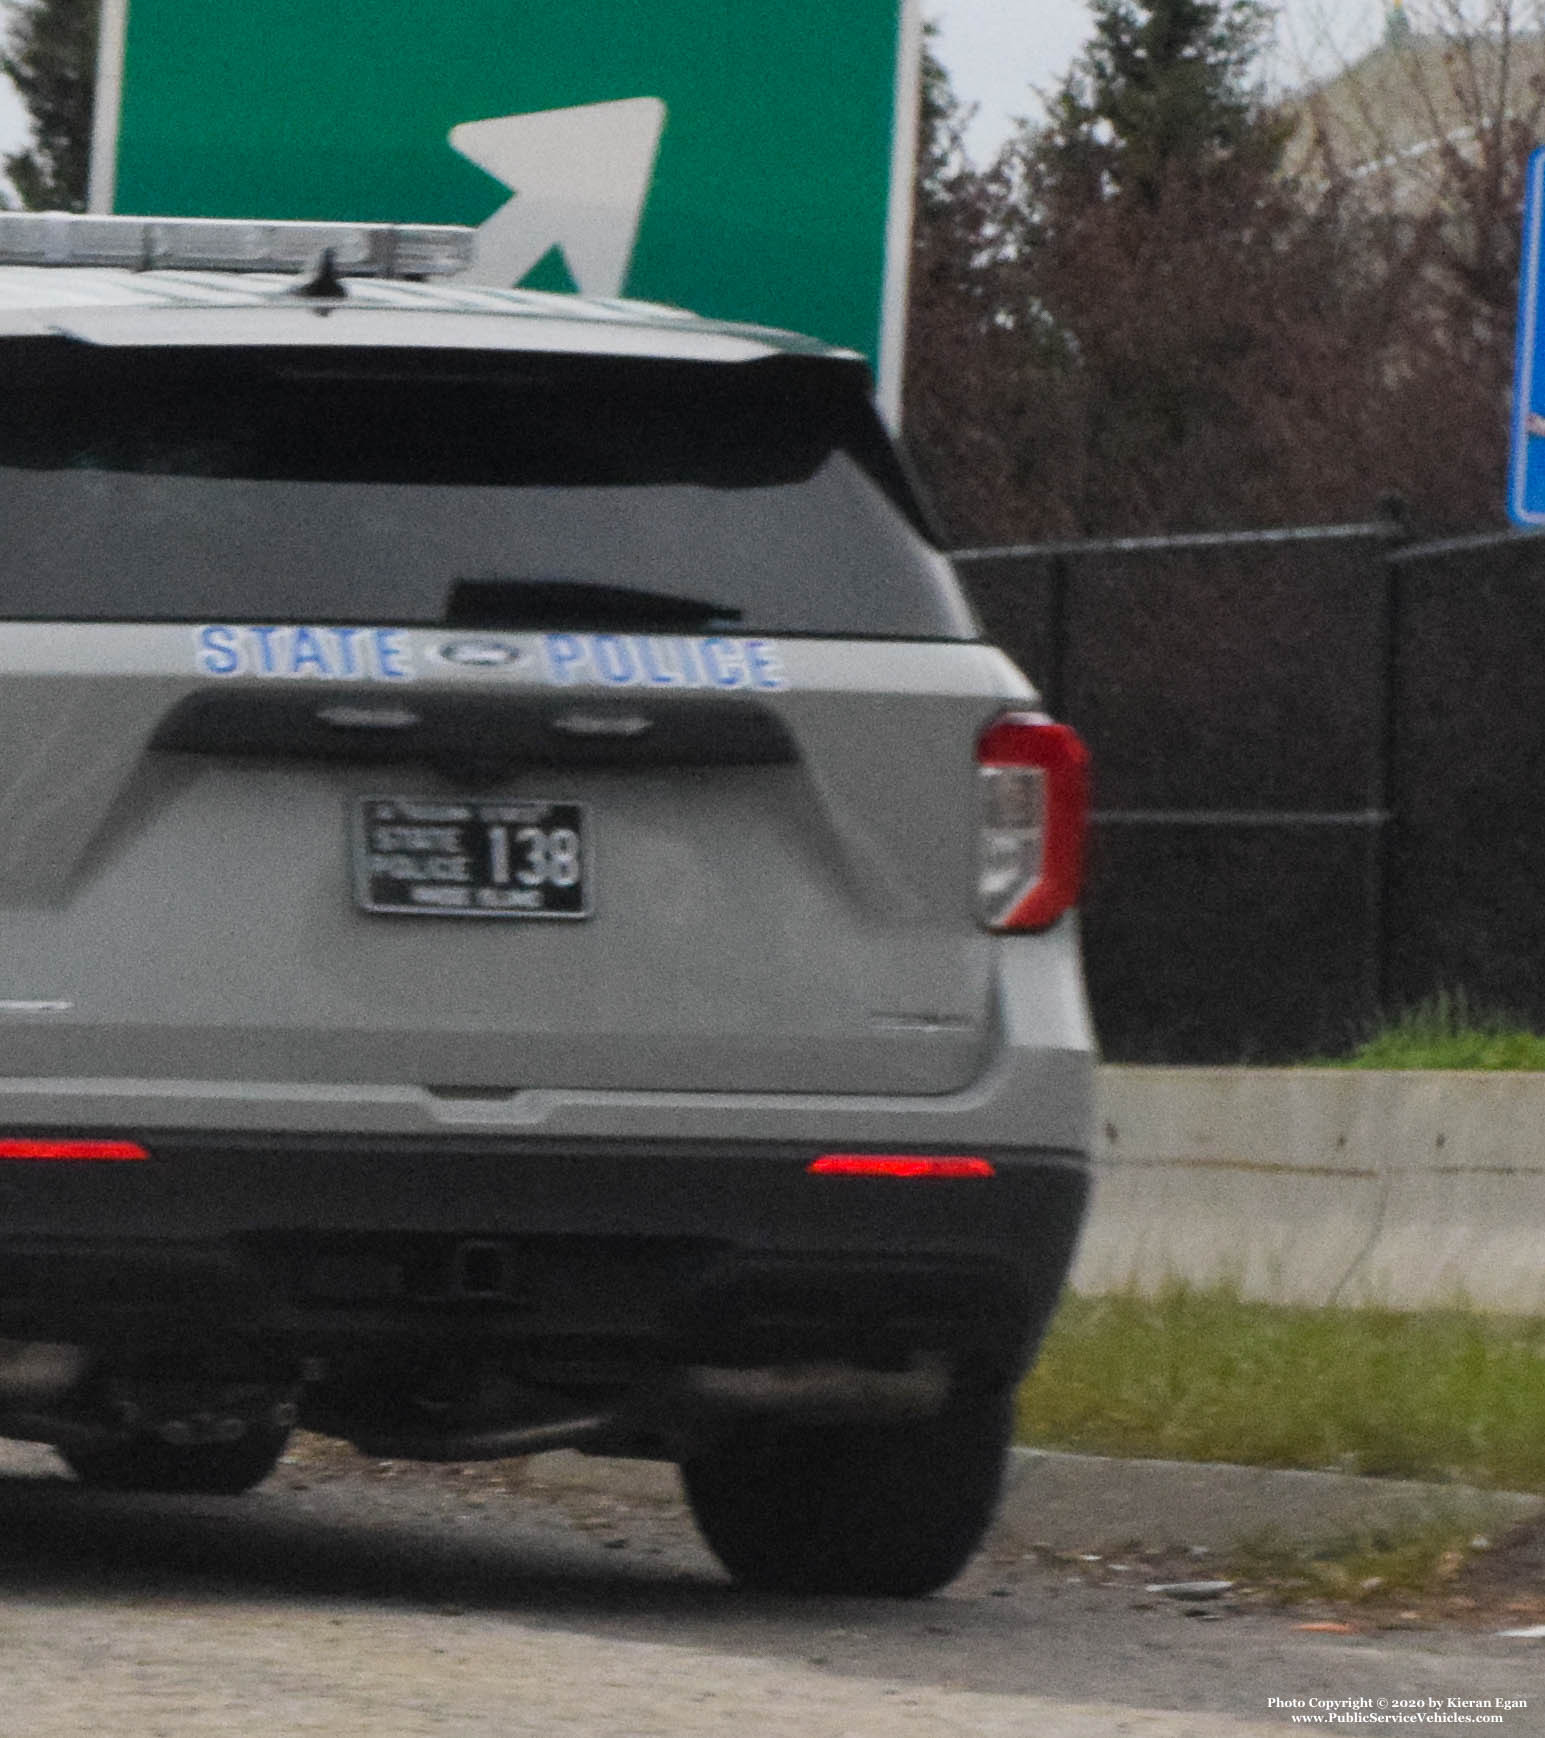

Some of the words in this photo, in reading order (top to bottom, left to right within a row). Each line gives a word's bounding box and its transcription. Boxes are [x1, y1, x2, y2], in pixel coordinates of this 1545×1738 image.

[197, 625, 413, 679] STATE
[539, 633, 787, 690] POLICE
[374, 827, 463, 852] STATE
[488, 826, 579, 887] 138
